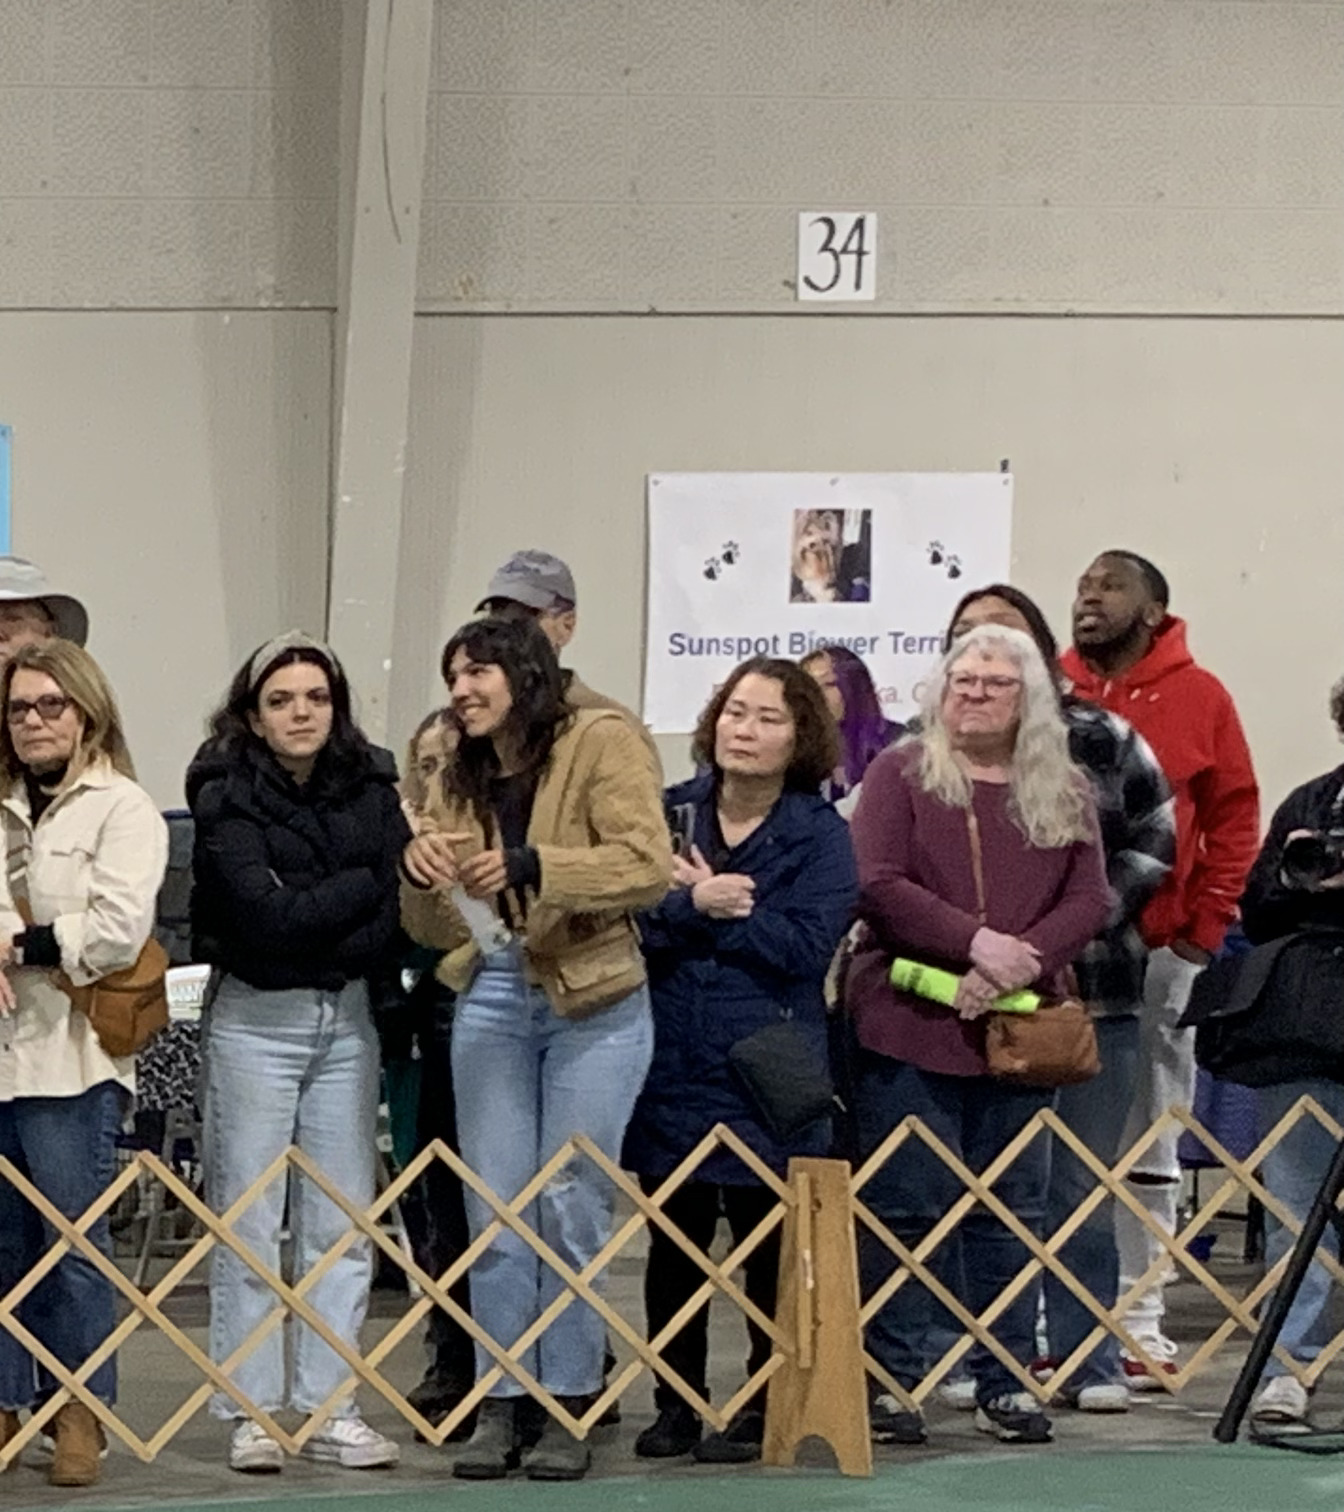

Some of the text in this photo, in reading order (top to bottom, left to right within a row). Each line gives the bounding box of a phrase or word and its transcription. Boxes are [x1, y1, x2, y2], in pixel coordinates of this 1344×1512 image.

[802, 215, 871, 293] 34
[669, 631, 780, 661] Sunspot
[888, 630, 948, 655] Terri
